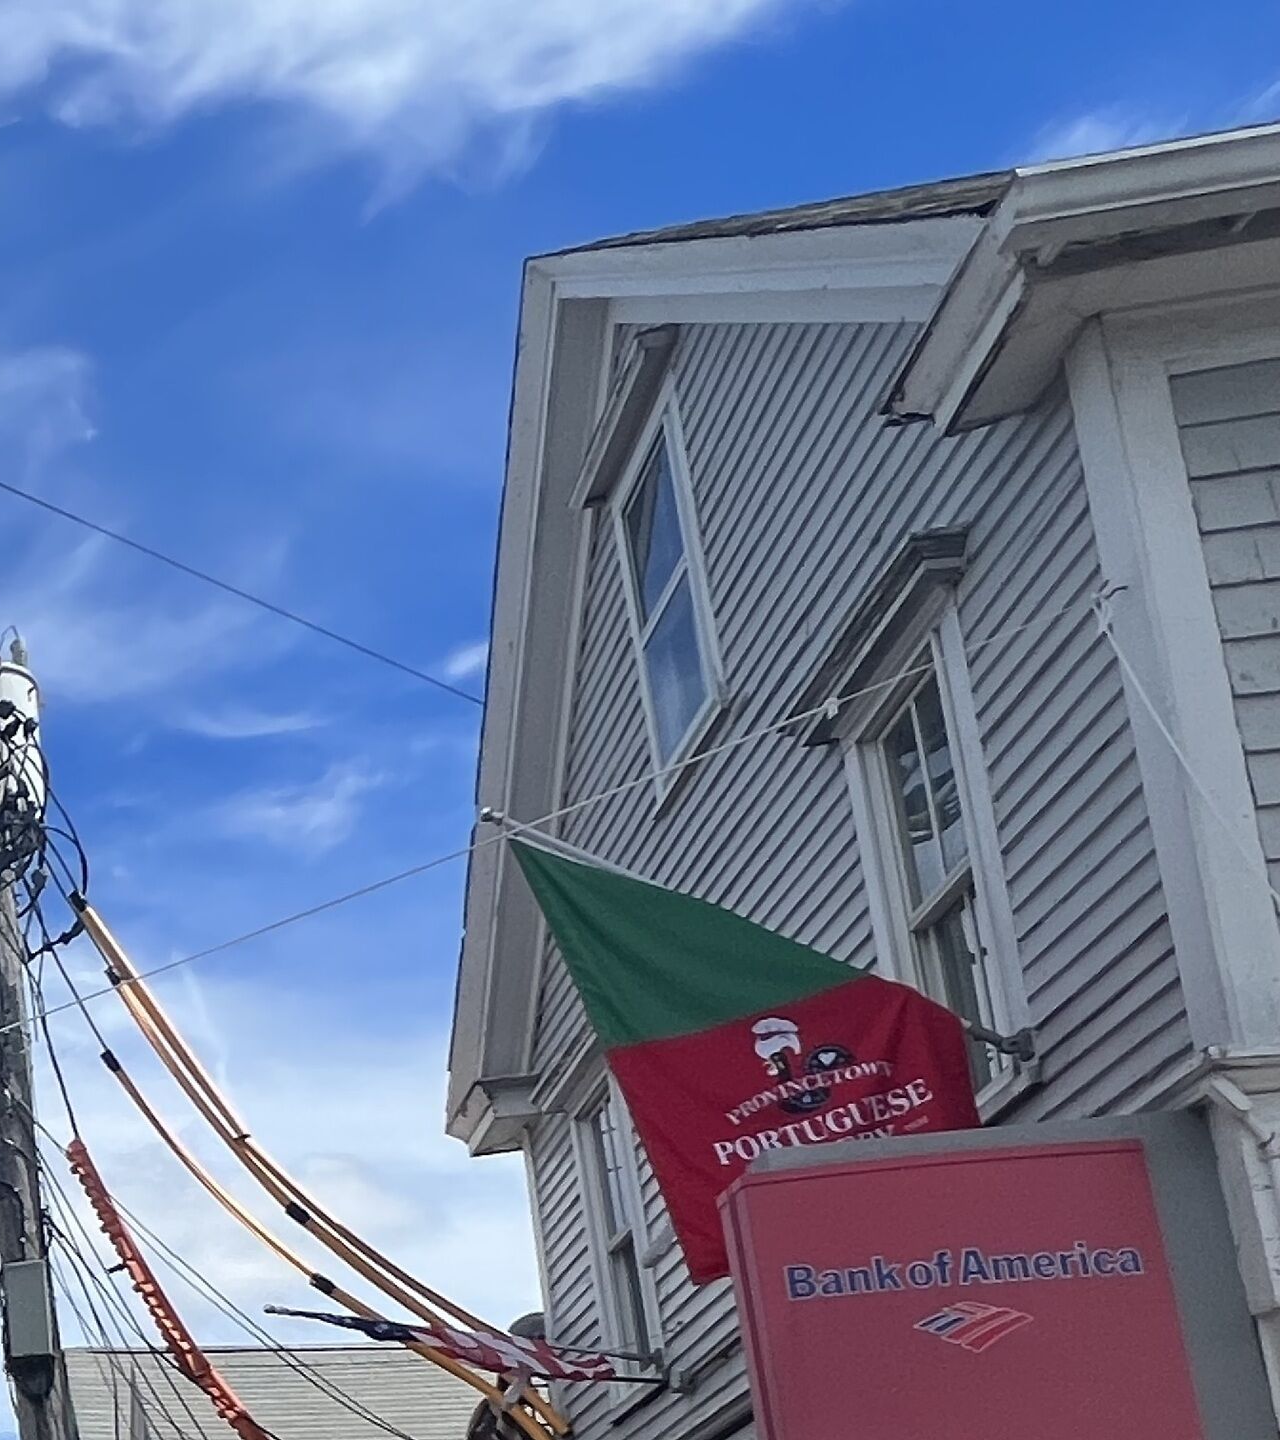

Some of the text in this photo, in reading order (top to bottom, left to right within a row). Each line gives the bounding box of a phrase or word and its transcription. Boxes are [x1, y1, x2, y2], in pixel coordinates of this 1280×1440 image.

[712, 1078, 933, 1165] PORTUGUESE
[784, 1240, 1145, 1301] Bank of America
